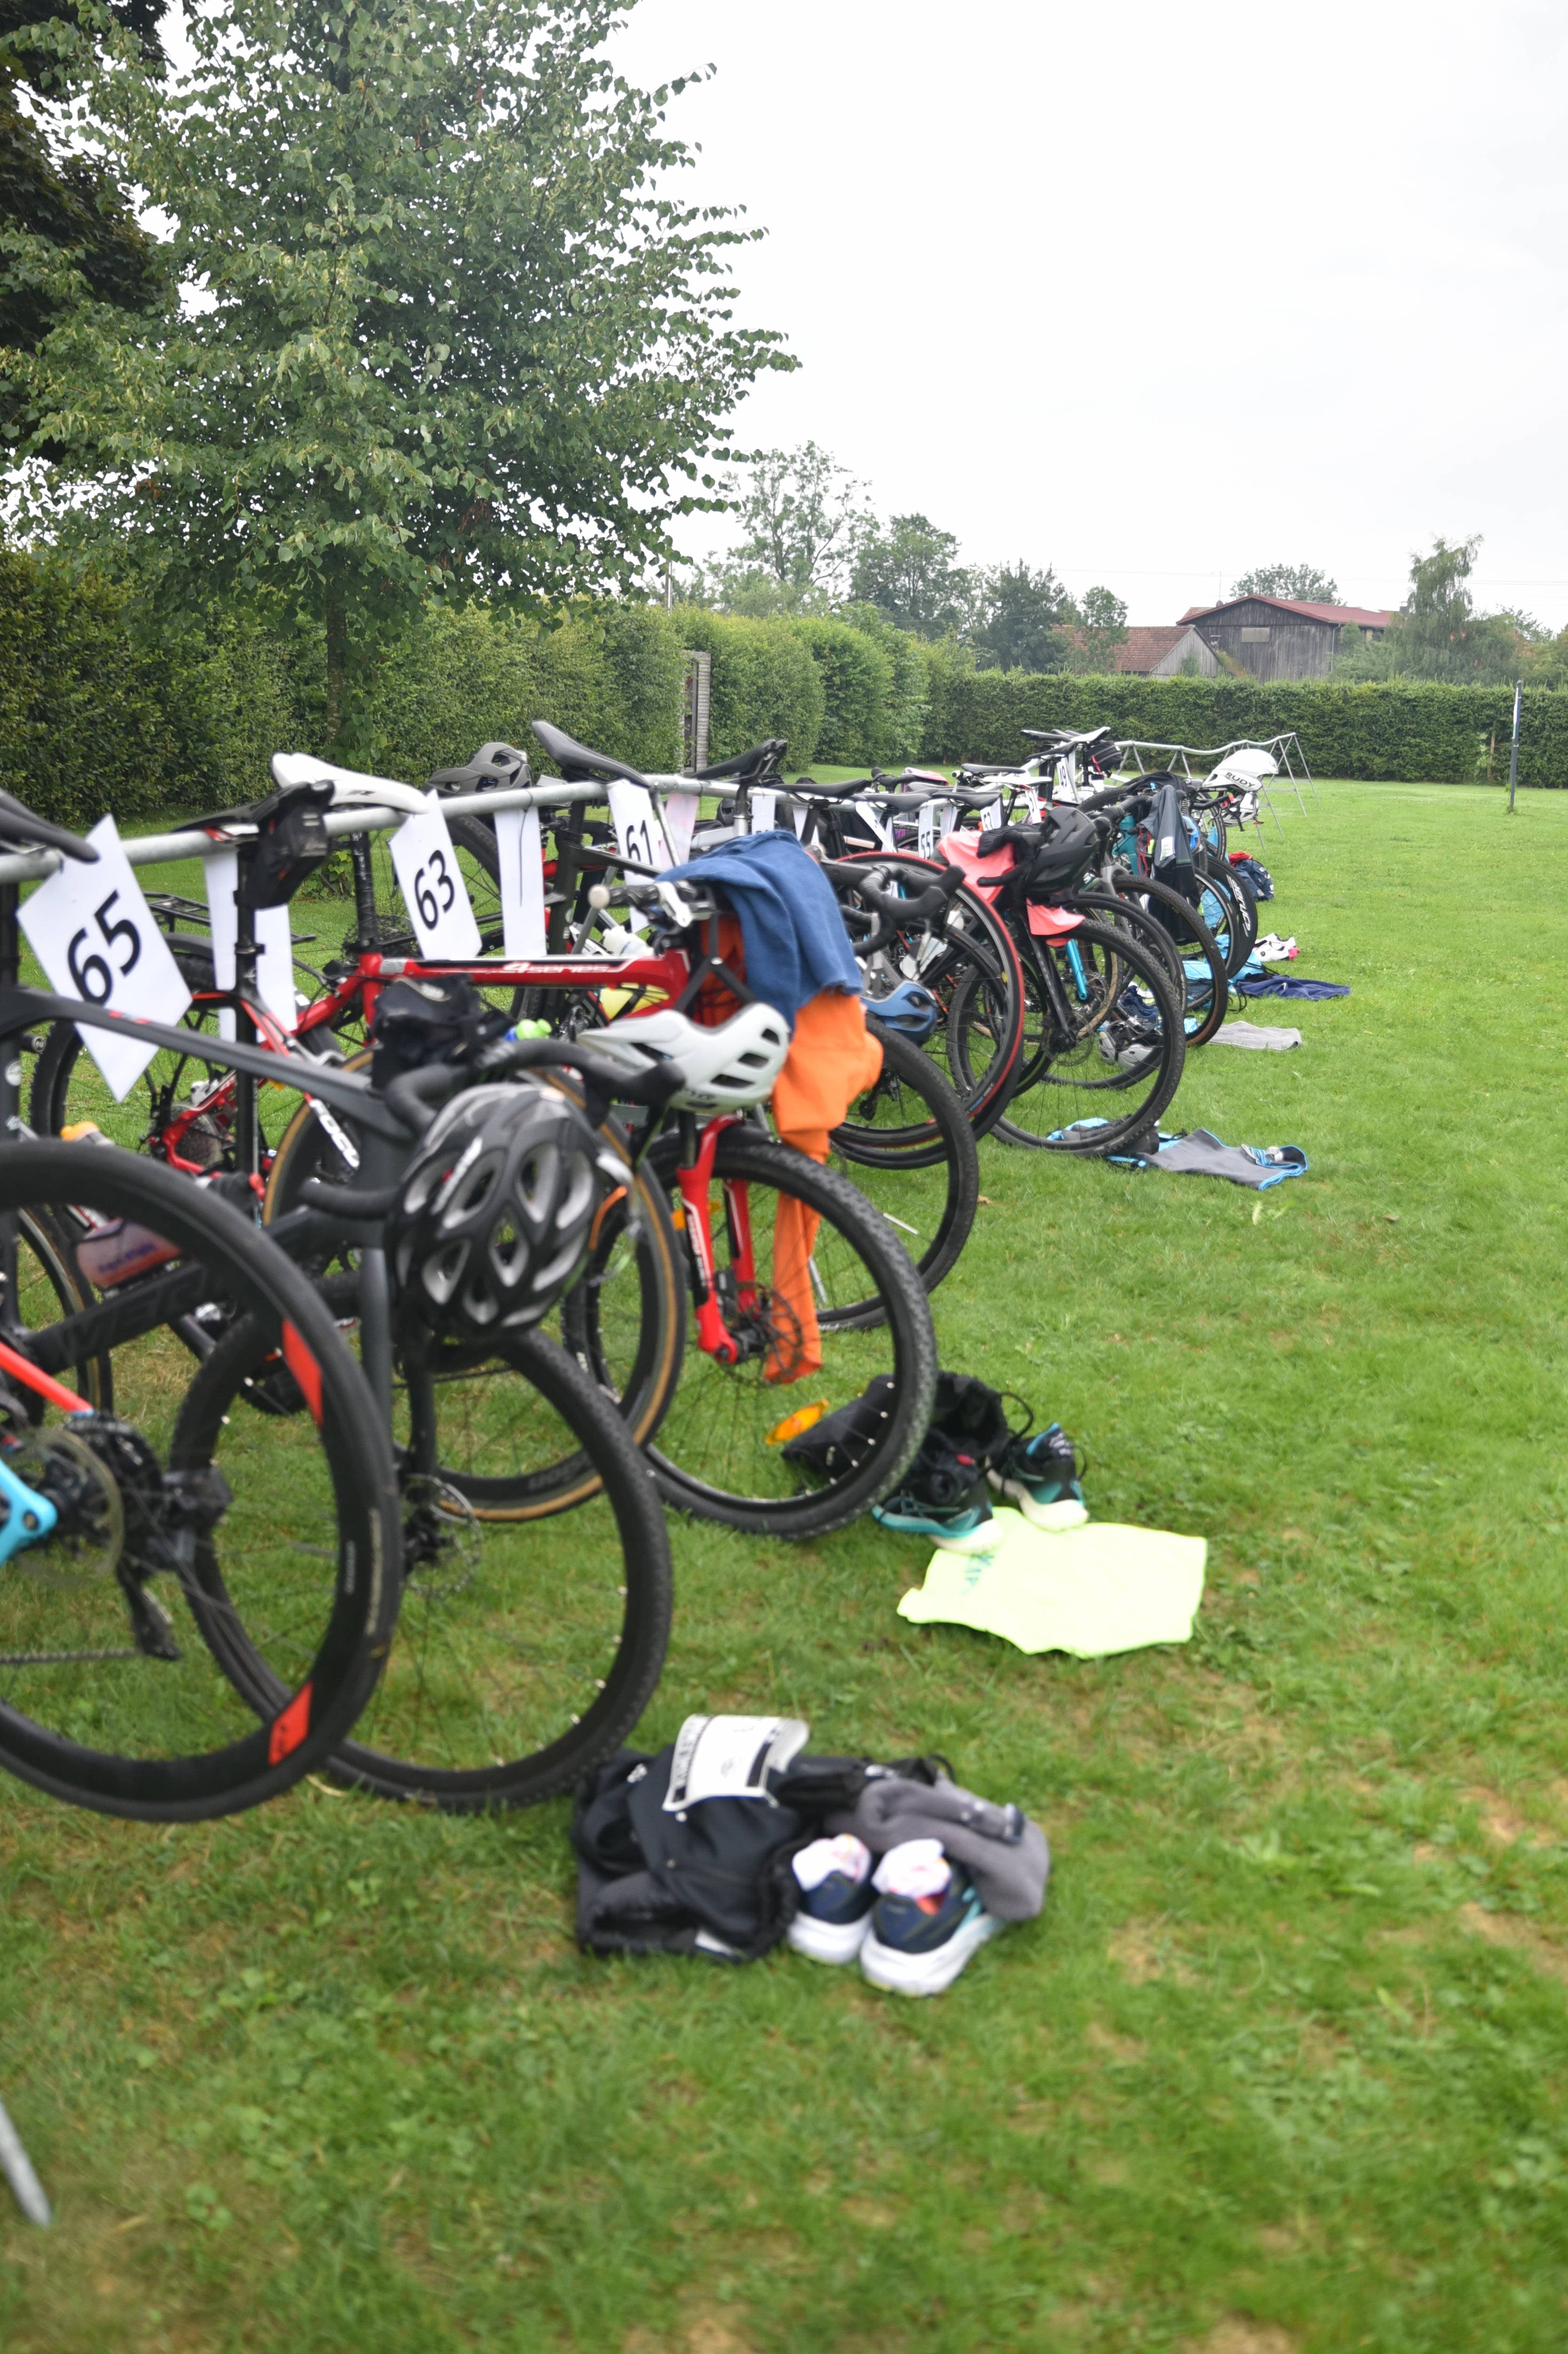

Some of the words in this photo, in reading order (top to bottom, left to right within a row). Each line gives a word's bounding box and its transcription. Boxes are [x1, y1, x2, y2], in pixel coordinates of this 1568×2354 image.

[1059, 766, 1067, 789] 49
[1225, 772, 1255, 788] RUDY
[626, 819, 653, 866] 61
[921, 831, 931, 860] 55
[414, 849, 455, 931] 63
[67, 889, 141, 1007] 65
[308, 1099, 361, 1169] FOCU
